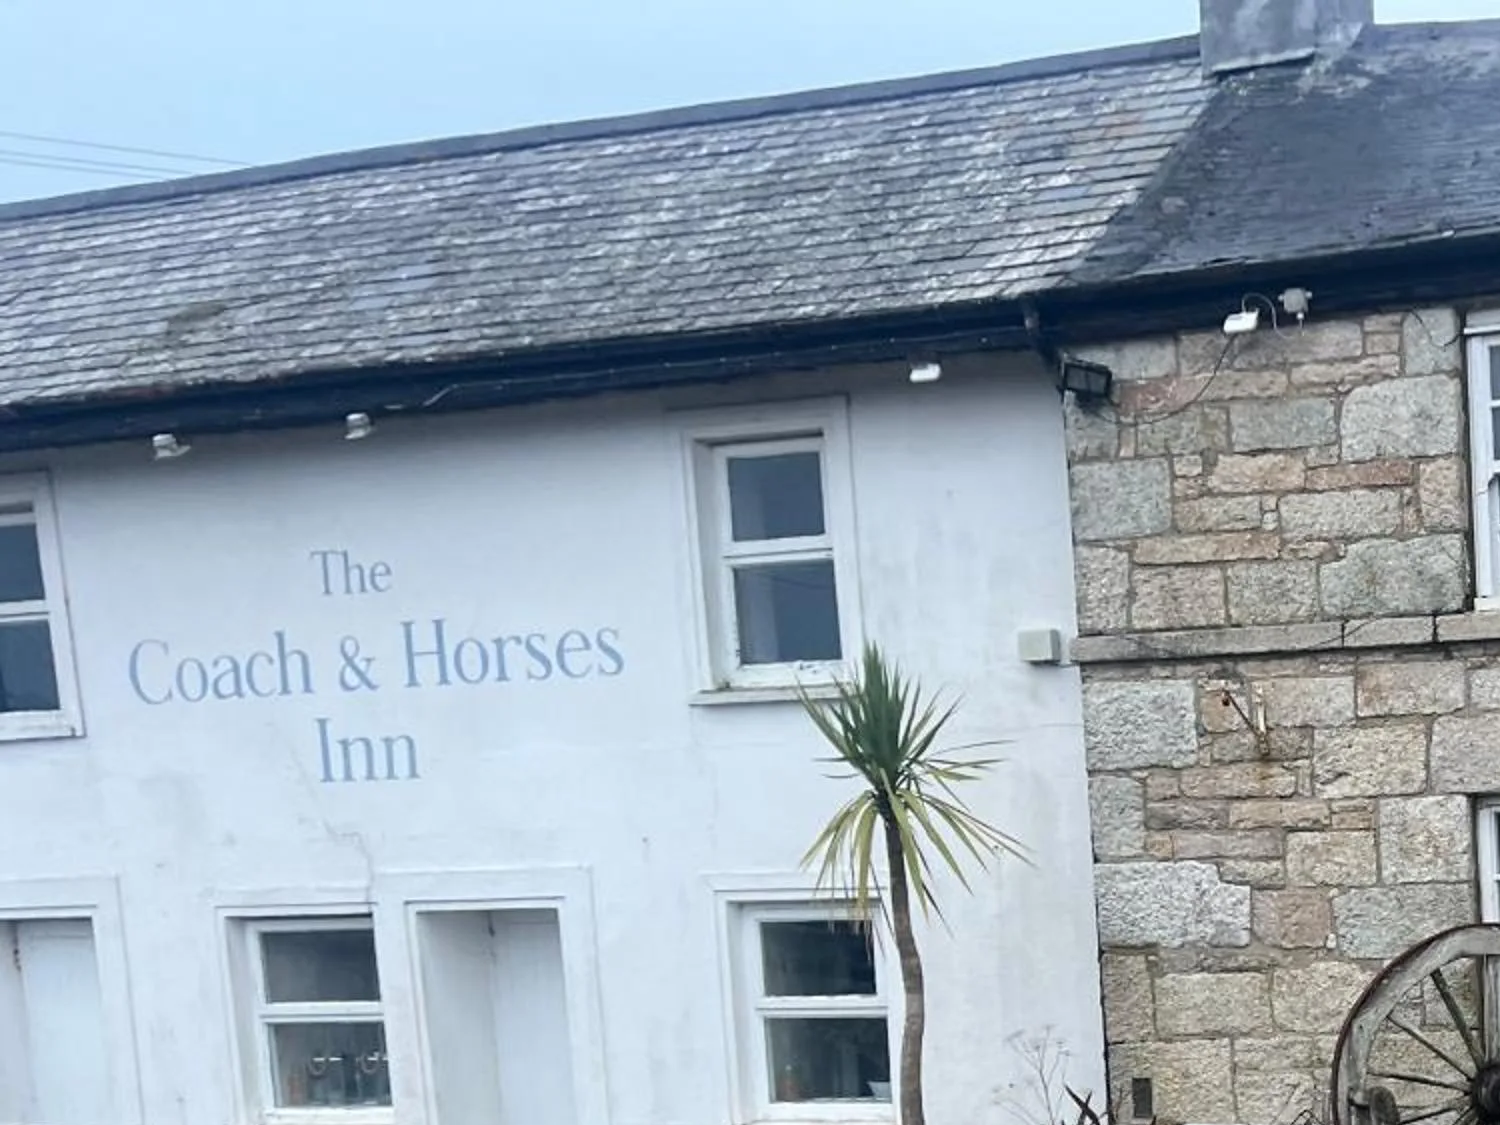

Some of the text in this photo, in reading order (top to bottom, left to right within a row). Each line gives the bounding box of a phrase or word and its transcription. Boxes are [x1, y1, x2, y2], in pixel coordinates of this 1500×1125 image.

[310, 549, 393, 596] The
[127, 617, 626, 705] Coach & Horses
[313, 717, 421, 783] Inn
